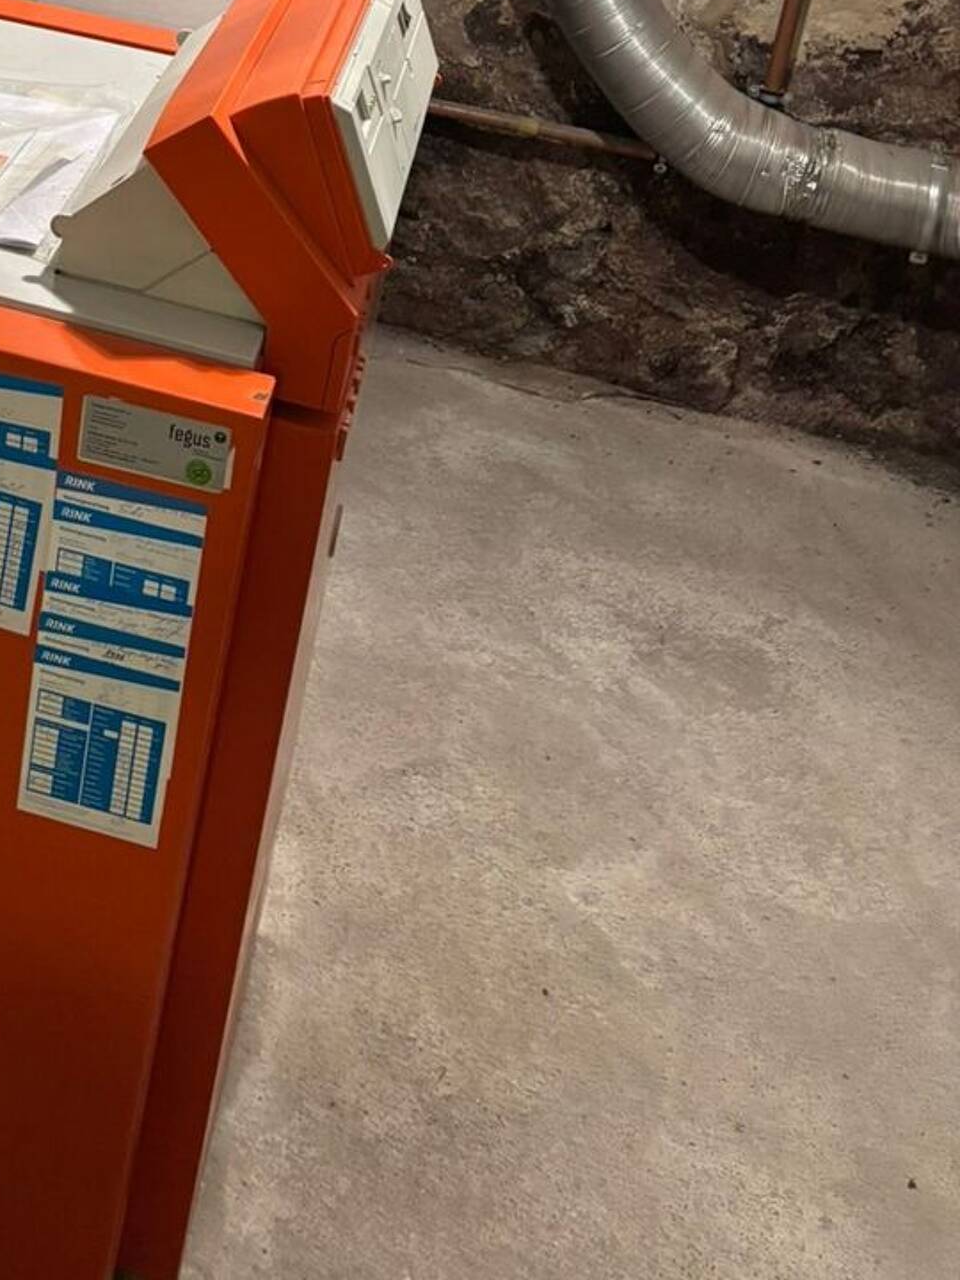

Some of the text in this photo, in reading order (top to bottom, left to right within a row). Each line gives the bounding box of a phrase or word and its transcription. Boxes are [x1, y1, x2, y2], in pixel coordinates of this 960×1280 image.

[168, 423, 212, 449] fegus
[64, 475, 96, 492] RINK
[60, 506, 92, 523] RINK
[50, 578, 81, 594] RINK
[45, 618, 76, 634] RINK
[41, 650, 72, 666] RINK
